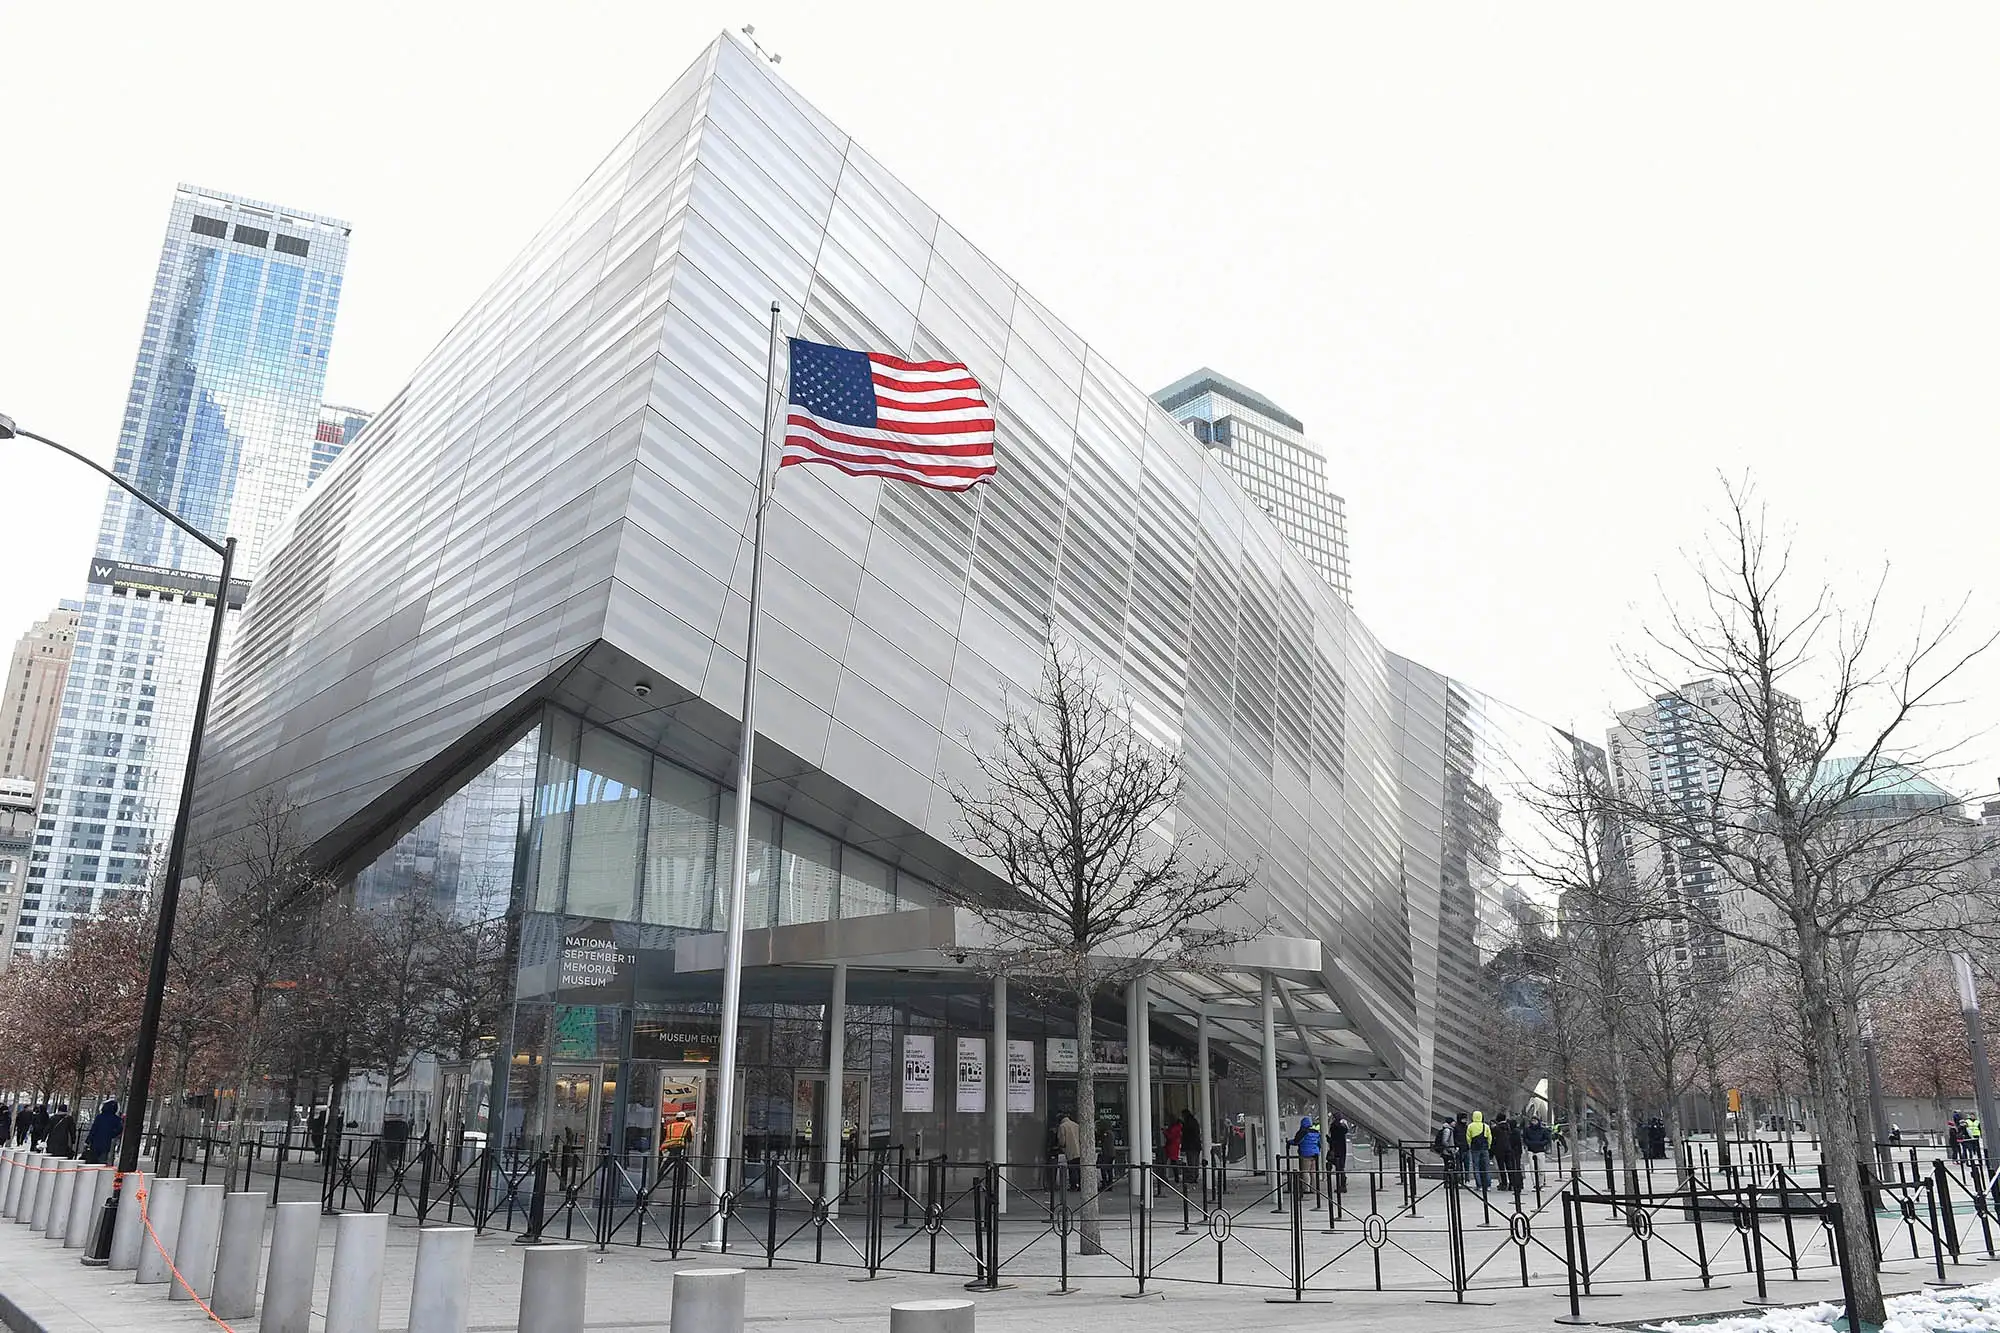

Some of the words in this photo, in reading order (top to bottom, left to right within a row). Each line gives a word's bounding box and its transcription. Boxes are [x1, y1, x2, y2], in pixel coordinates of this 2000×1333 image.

[95, 565, 113, 578] W
[131, 564, 170, 575] RESIDENCES
[565, 936, 619, 950] NATIONAL
[564, 949, 625, 963] SEPTEMBER
[627, 955, 636, 964] 11
[563, 962, 618, 975] MEMORIAL
[562, 975, 606, 987] MUSEUM
[659, 1032, 698, 1043] MUSEUM
